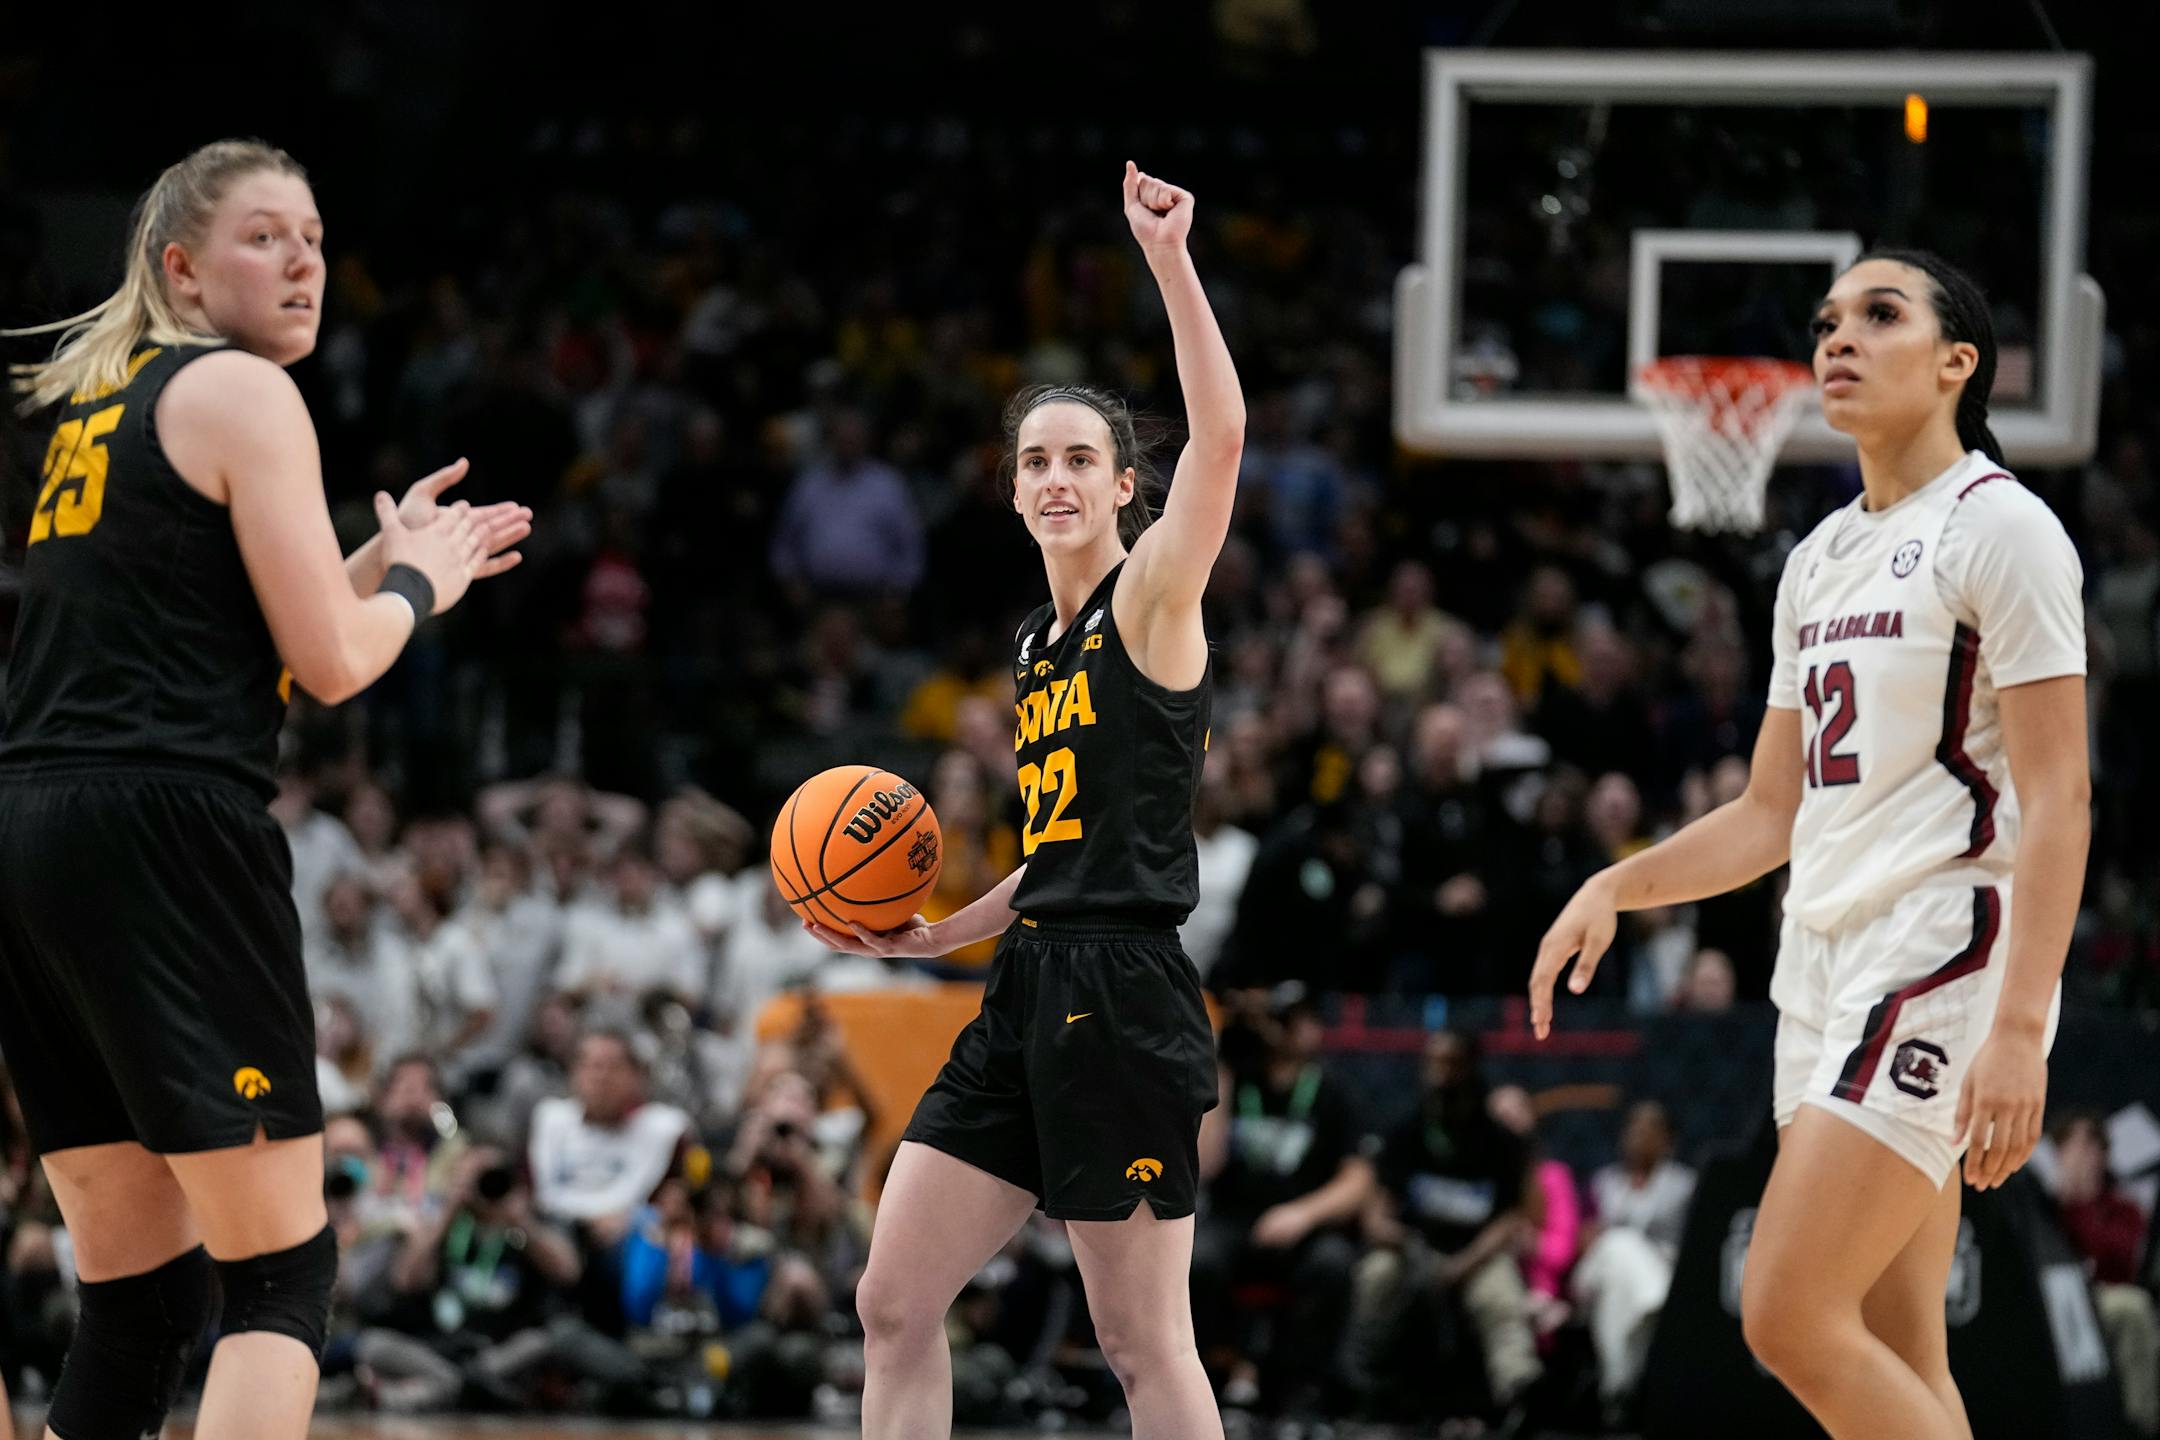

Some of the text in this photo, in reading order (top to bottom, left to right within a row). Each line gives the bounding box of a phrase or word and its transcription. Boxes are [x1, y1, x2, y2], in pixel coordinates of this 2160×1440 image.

[28, 403, 126, 546] 25
[1015, 670, 1097, 753] OWA
[1804, 660, 1860, 788] 12
[842, 782, 919, 844] Wilson
[1017, 746, 1083, 857] 22
